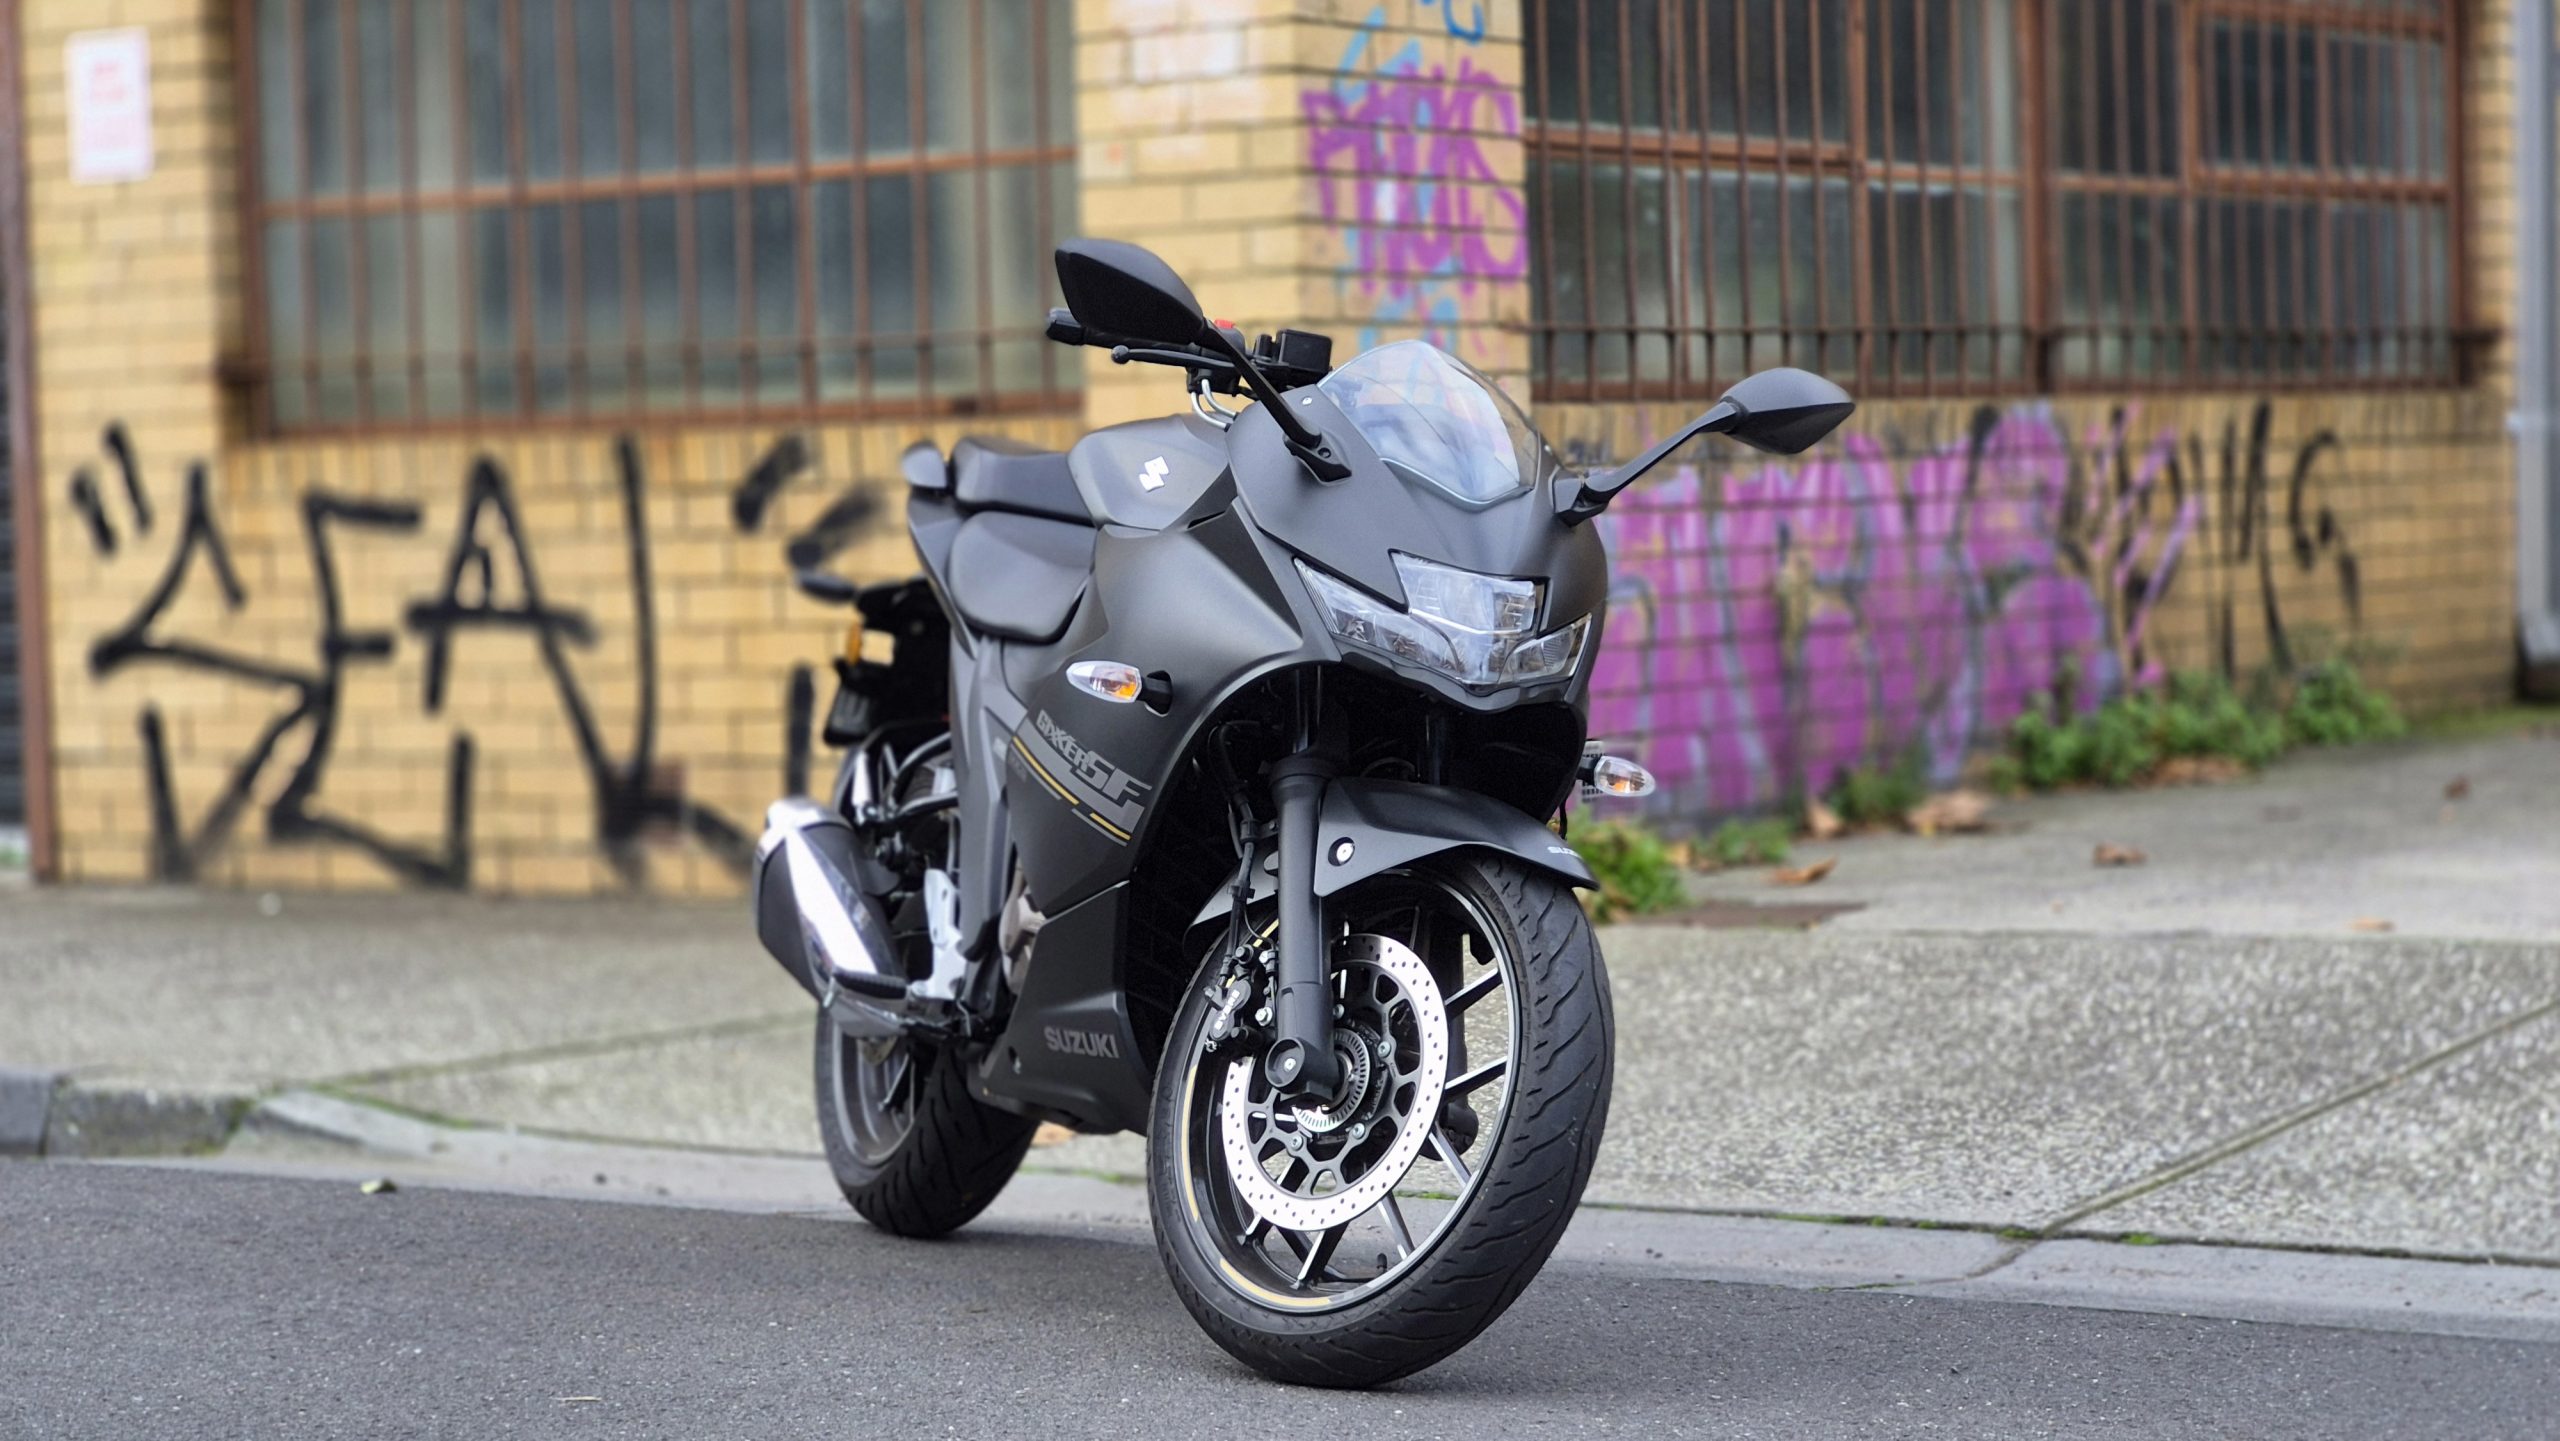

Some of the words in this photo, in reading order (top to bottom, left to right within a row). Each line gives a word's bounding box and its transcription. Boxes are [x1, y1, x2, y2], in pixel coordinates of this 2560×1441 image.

[1036, 709, 1090, 773] GIXXER
[1075, 750, 1153, 801] SF
[1043, 1026, 1120, 1059] SUZUKI
